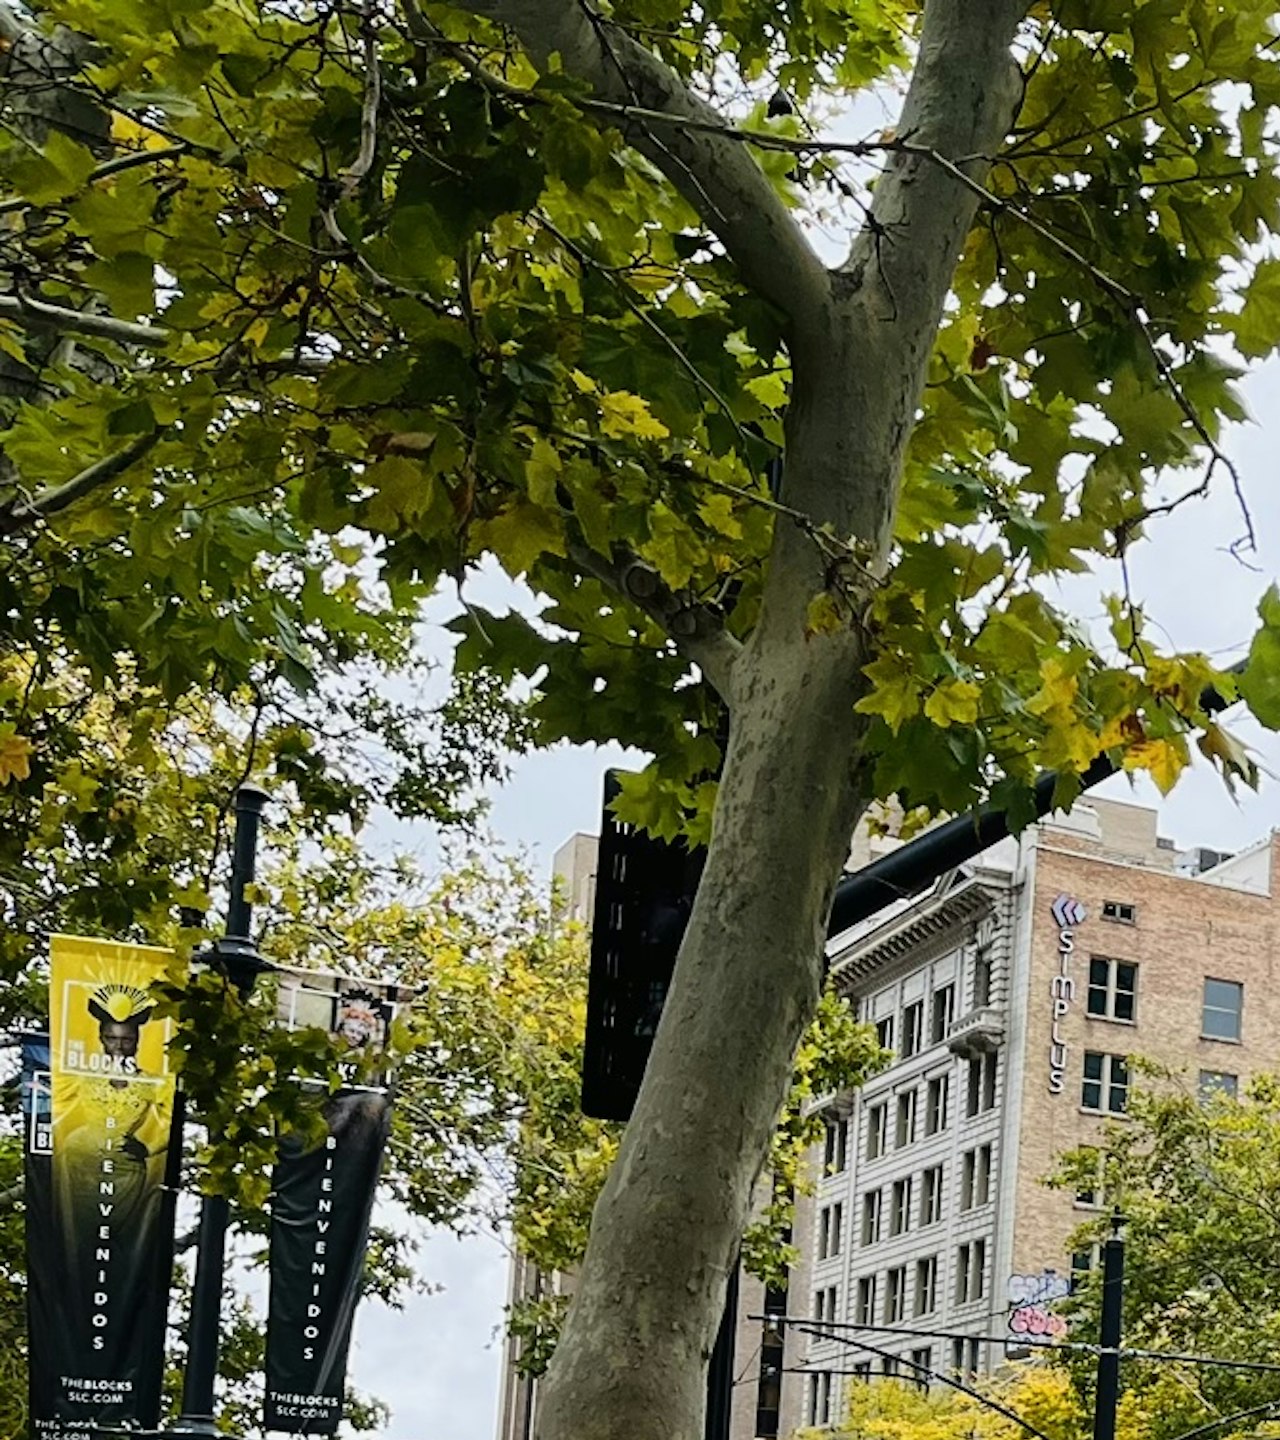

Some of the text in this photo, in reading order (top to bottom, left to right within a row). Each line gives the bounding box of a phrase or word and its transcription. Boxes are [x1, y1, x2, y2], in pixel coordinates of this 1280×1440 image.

[67, 1051, 136, 1074] BLOCKS
[92, 1116, 118, 1350] BIENVENIDOS
[303, 1136, 337, 1359] BIENVENIDOS
